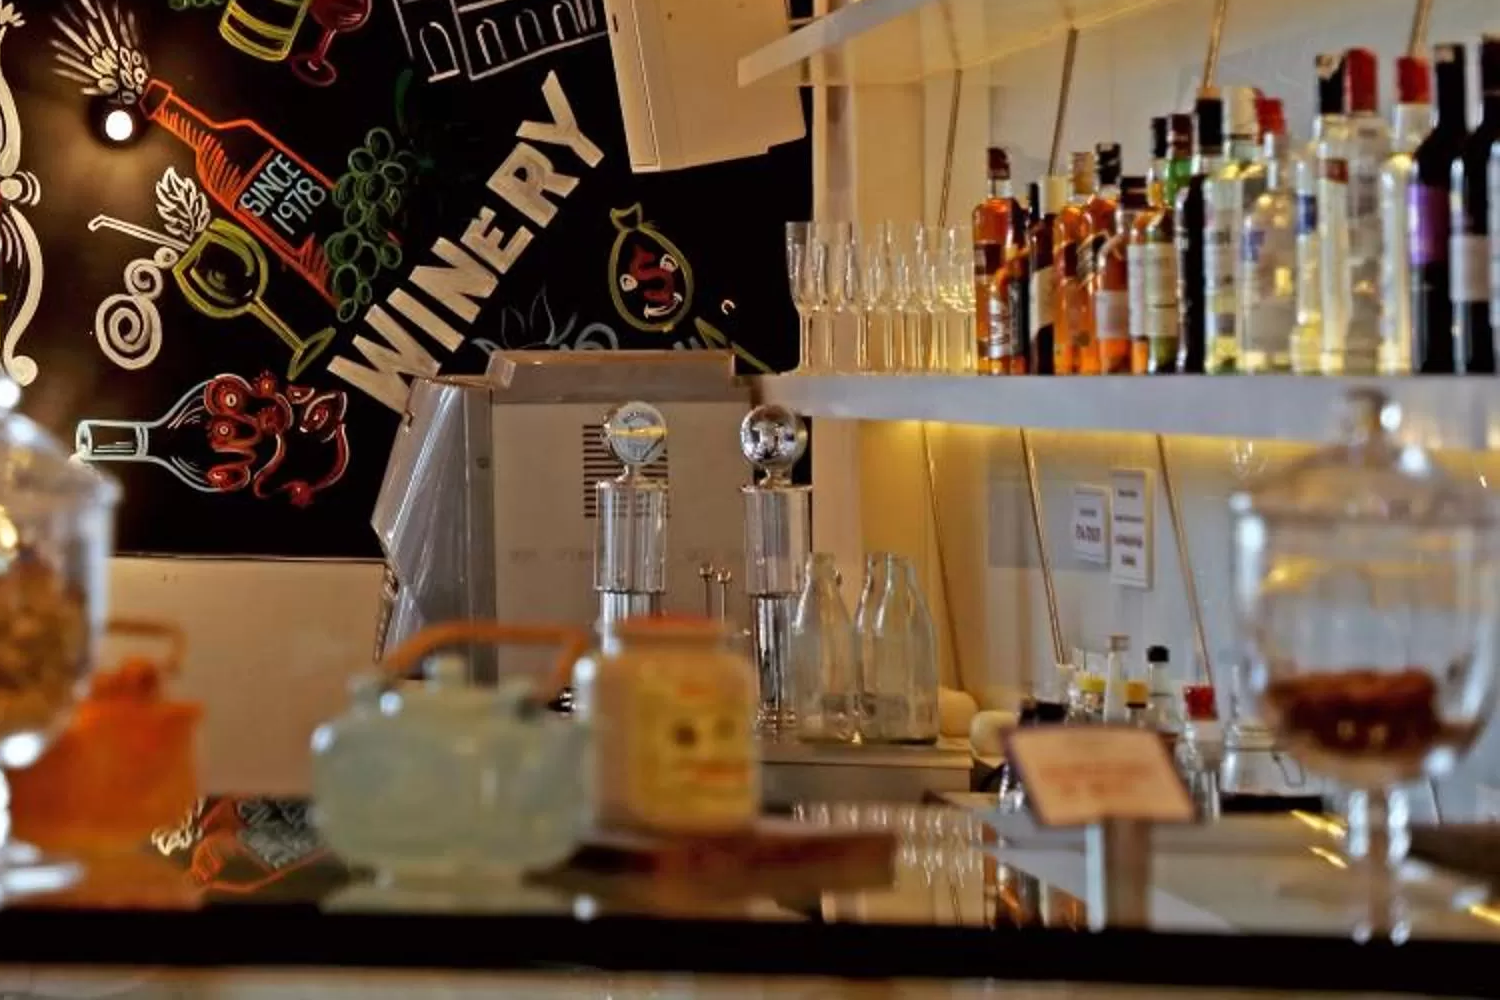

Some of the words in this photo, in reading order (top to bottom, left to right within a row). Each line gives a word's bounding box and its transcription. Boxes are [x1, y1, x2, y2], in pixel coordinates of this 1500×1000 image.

[239, 152, 301, 217] SINCE
[271, 177, 327, 236] 1978
[326, 70, 605, 415] WINERY
